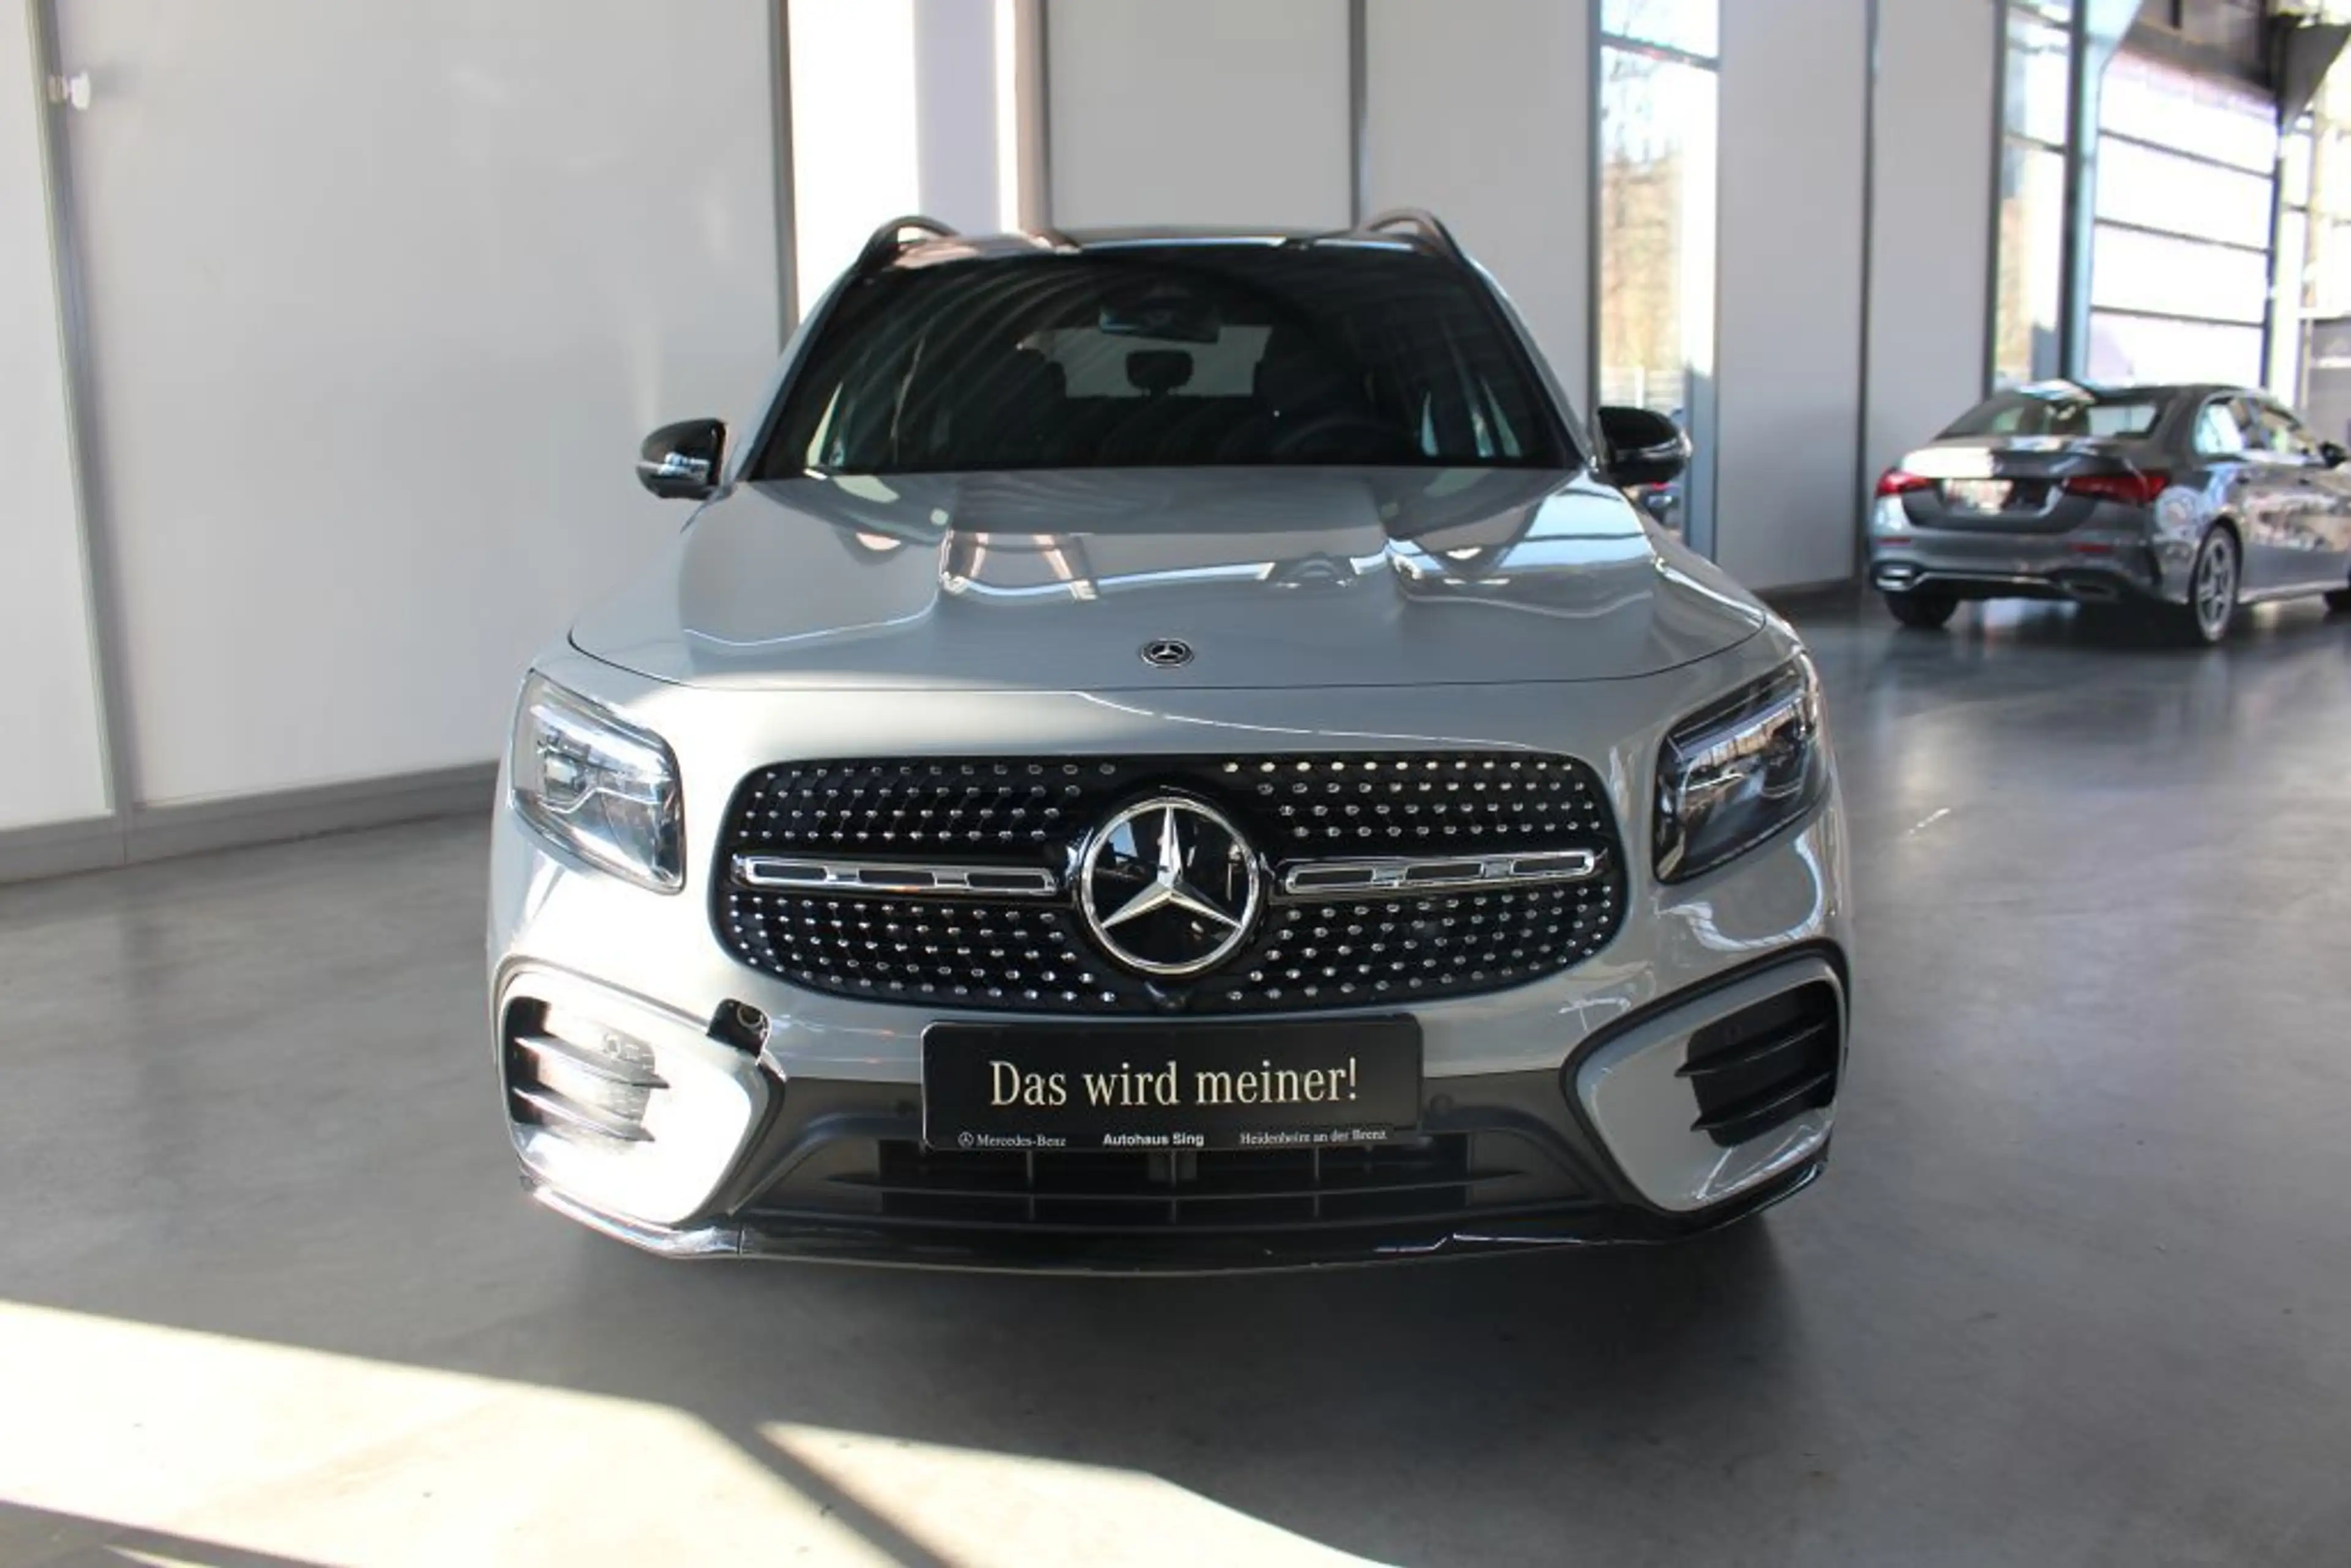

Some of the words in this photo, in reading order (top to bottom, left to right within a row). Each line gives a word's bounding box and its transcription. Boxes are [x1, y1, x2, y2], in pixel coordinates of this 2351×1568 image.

[989, 1060, 1067, 1106] Das
[1082, 1060, 1182, 1106] wird
[1196, 1056, 1357, 1105] meiner!
[977, 1133, 1067, 1147] Mercedes-Benz
[1103, 1133, 1169, 1147] Autohaus
[1172, 1131, 1205, 1147] Sing
[1313, 1133, 1328, 1142] an
[1330, 1129, 1349, 1142] der
